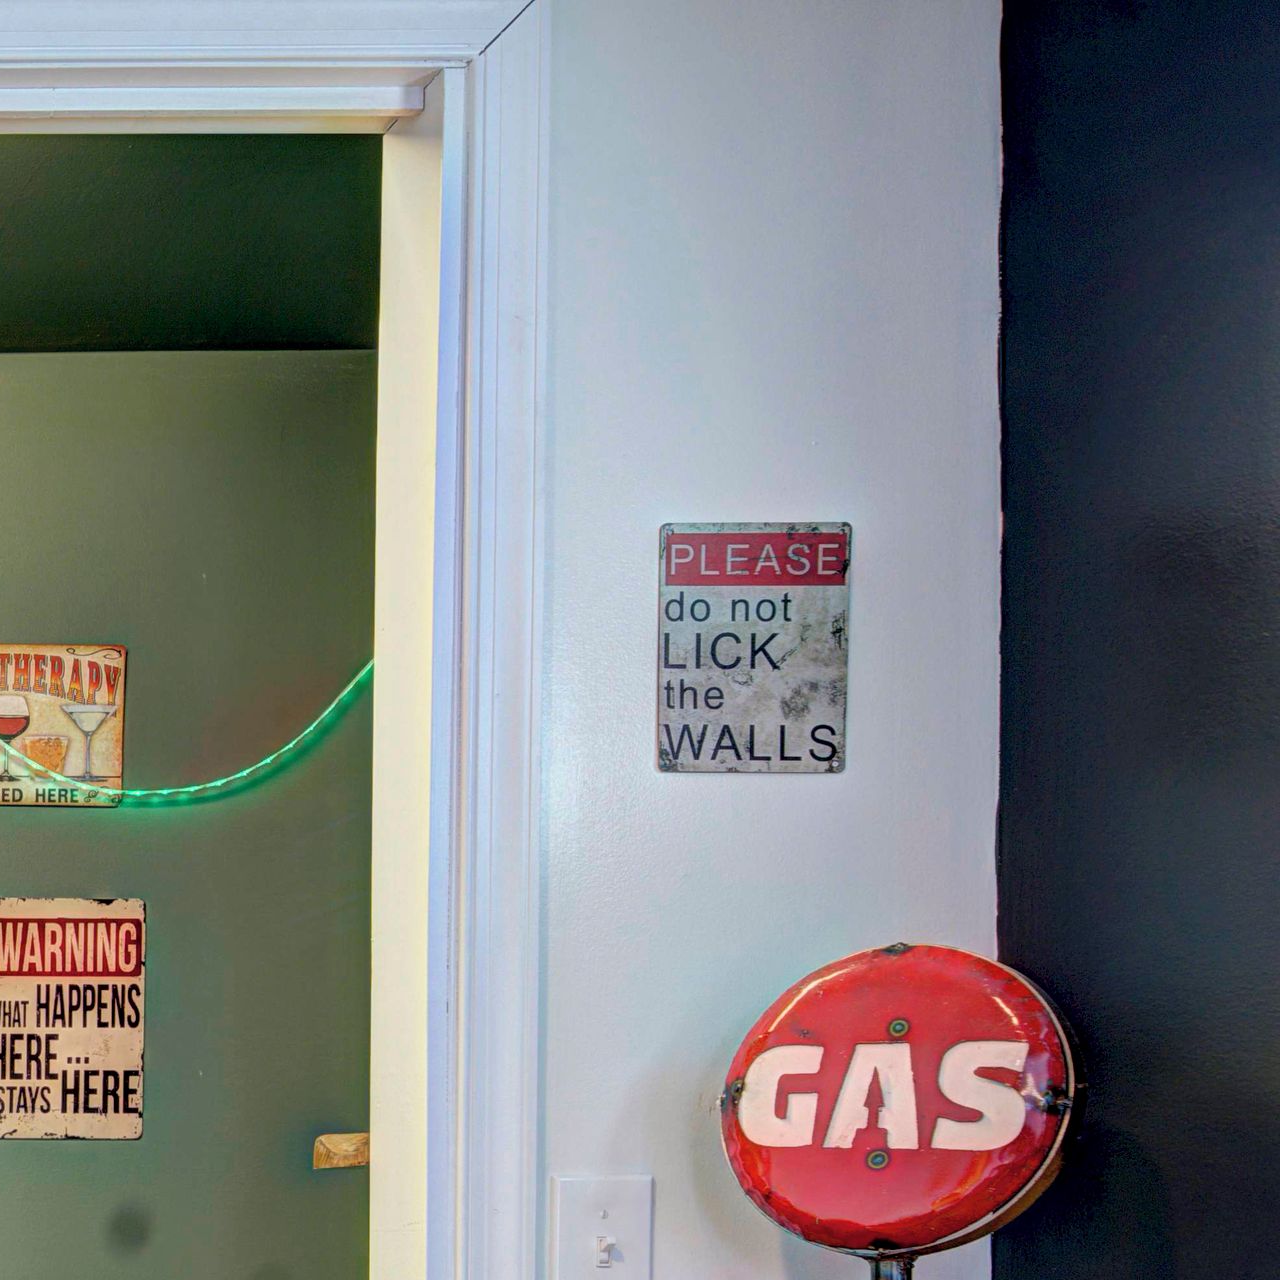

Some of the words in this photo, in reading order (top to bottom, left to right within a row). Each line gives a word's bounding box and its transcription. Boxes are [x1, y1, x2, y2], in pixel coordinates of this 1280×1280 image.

[669, 543, 840, 576] PLEASE
[664, 591, 711, 622] do
[730, 592, 792, 622] not
[663, 632, 781, 670] LICK
[663, 679, 725, 710] the
[663, 723, 838, 762] WALLS
[35, 788, 79, 803] HERE
[36, 984, 141, 1028] HAPPENS
[61, 1069, 140, 1114] HERE
[739, 1040, 1029, 1151] GAS
